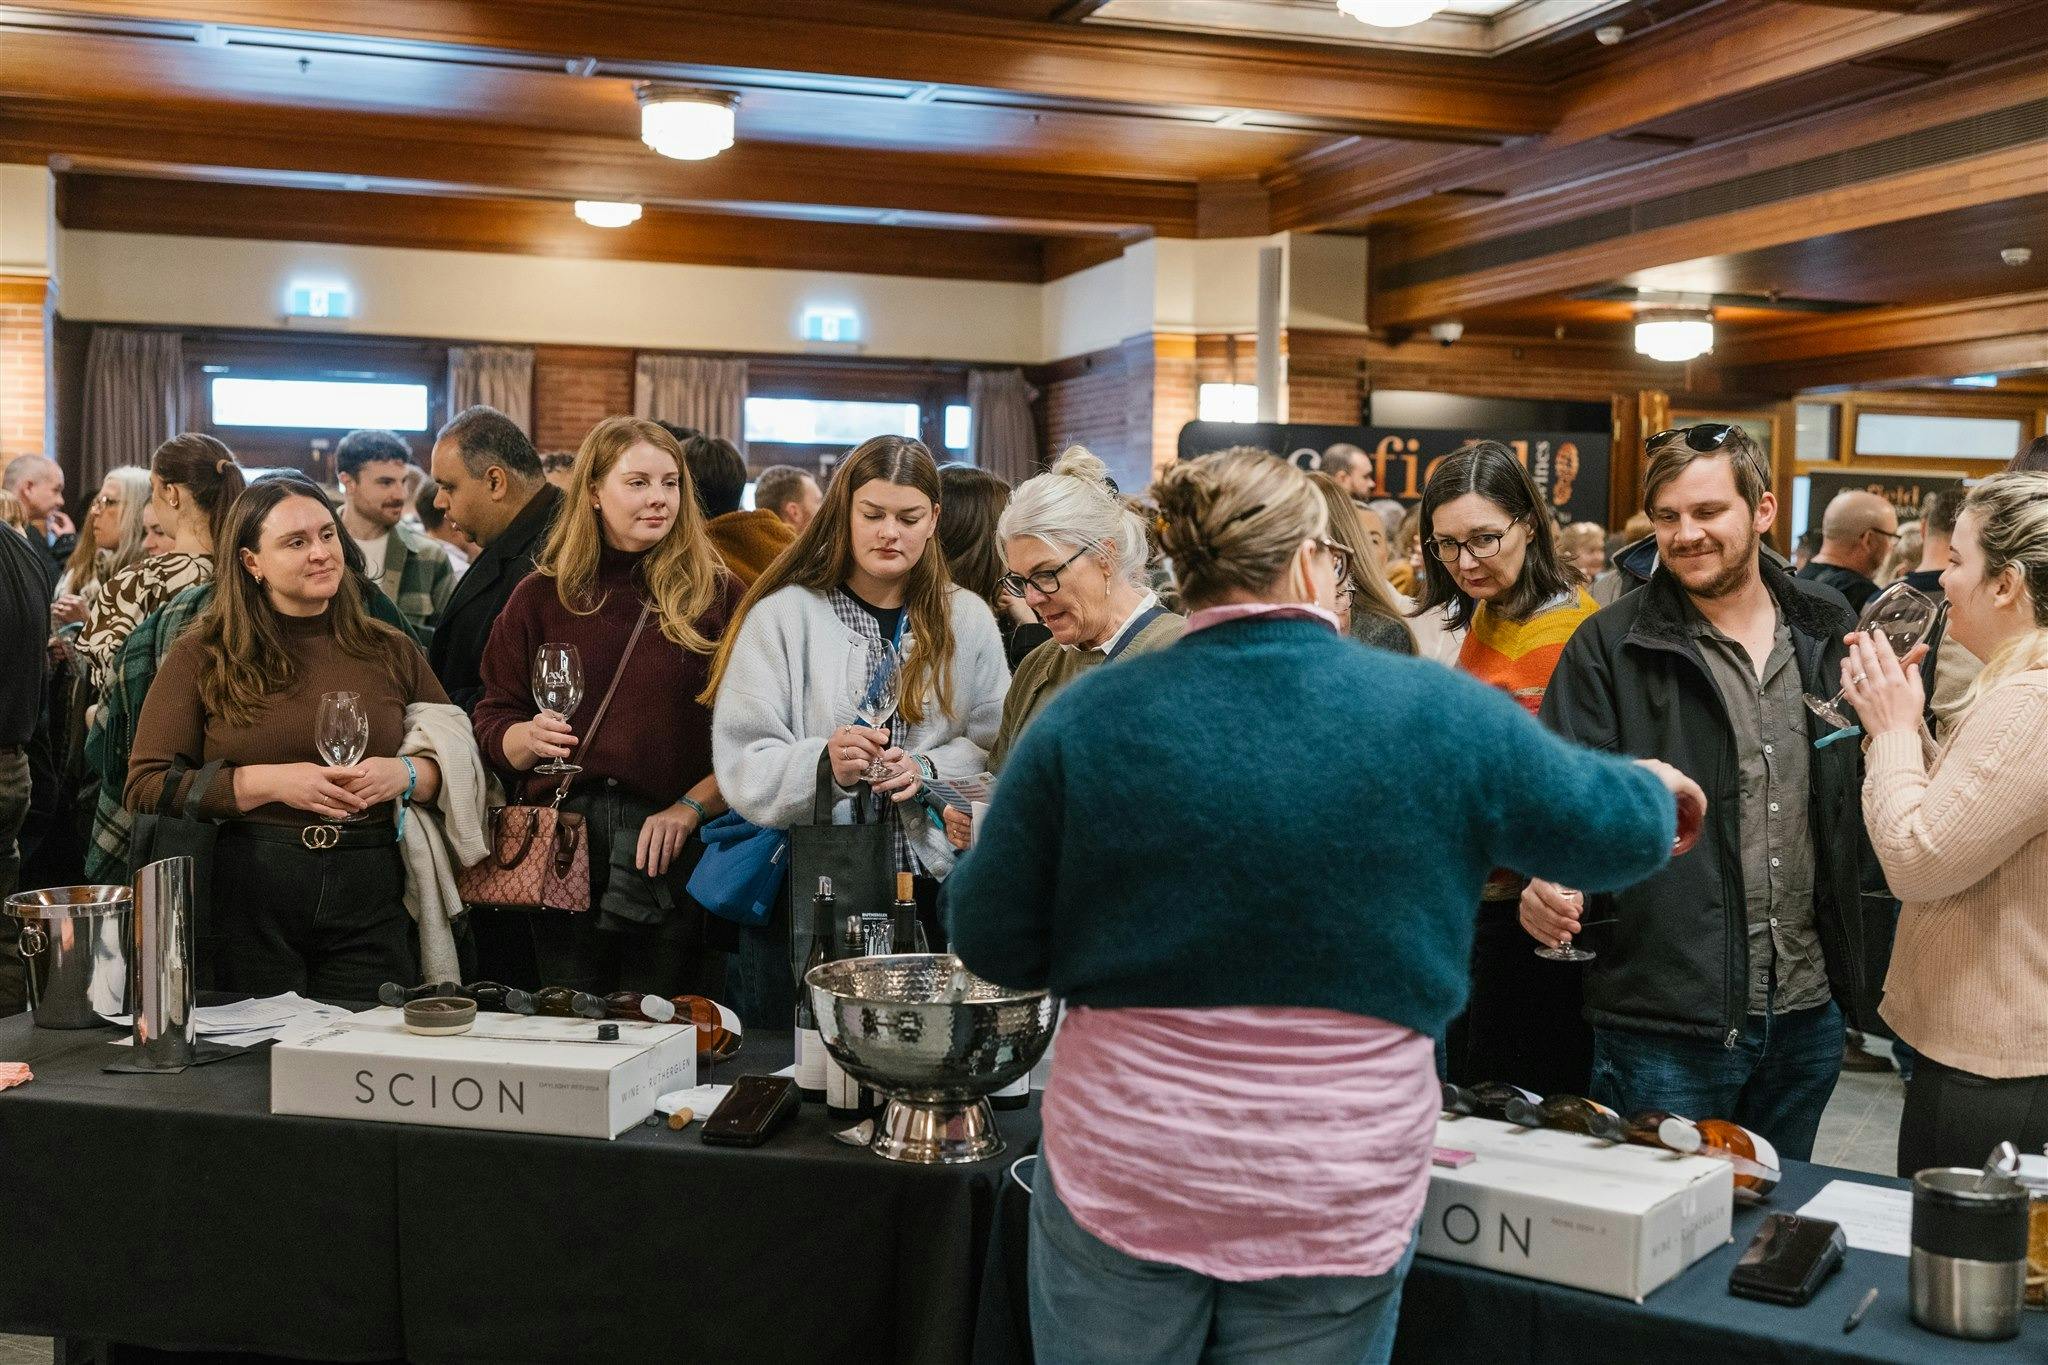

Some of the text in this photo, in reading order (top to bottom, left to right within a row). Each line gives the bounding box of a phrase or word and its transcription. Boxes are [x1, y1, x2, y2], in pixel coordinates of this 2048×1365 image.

[355, 1069, 524, 1115] SCION
[621, 1084, 640, 1103] WINE
[649, 1058, 690, 1088] RUTHERGLEN
[1420, 1203, 1530, 1257] ON
